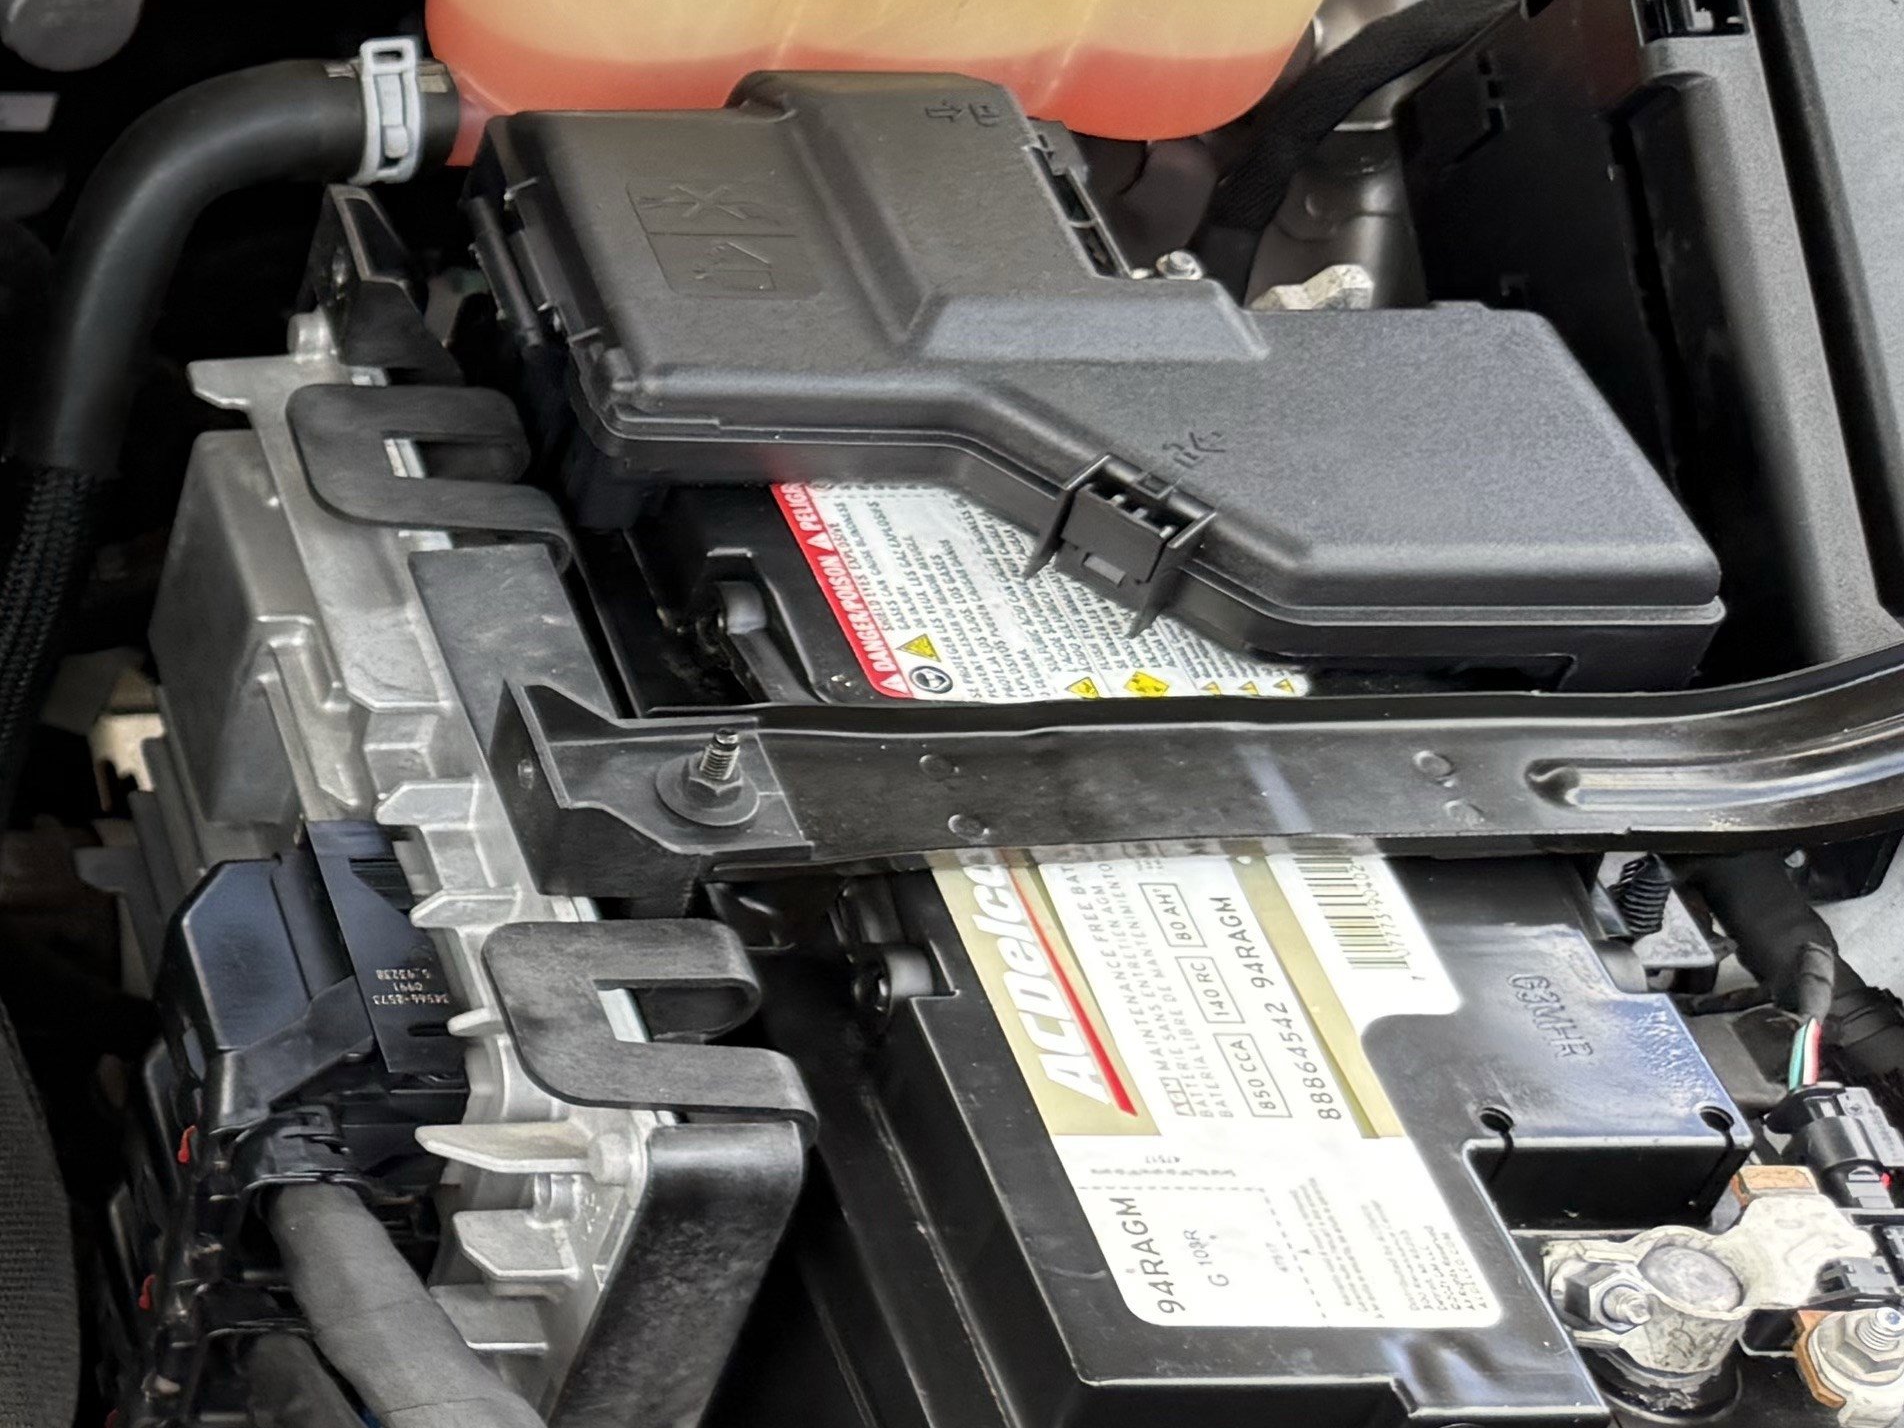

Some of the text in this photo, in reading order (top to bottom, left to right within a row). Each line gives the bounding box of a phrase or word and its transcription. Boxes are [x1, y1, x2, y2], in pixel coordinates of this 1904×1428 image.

[819, 555, 897, 672] DANGER/POISON
[1059, 865, 1087, 895] BAT
[1090, 885, 1114, 915] AGM
[1076, 902, 1109, 943] FREE
[1169, 921, 1193, 941] 80
[1208, 896, 1275, 989] 94RAGM
[963, 865, 1112, 1105] ACDelco
[1100, 949, 1171, 1071] MAINTENANCE
[1189, 962, 1230, 1016] 140 RC
[1148, 1004, 1177, 1041] SANS
[1168, 1047, 1215, 1118] BATTERIE
[1229, 1039, 1277, 1110] 850 CCA
[1263, 1002, 1343, 1121] 88864542
[1109, 1197, 1187, 1314] 94RAGM
